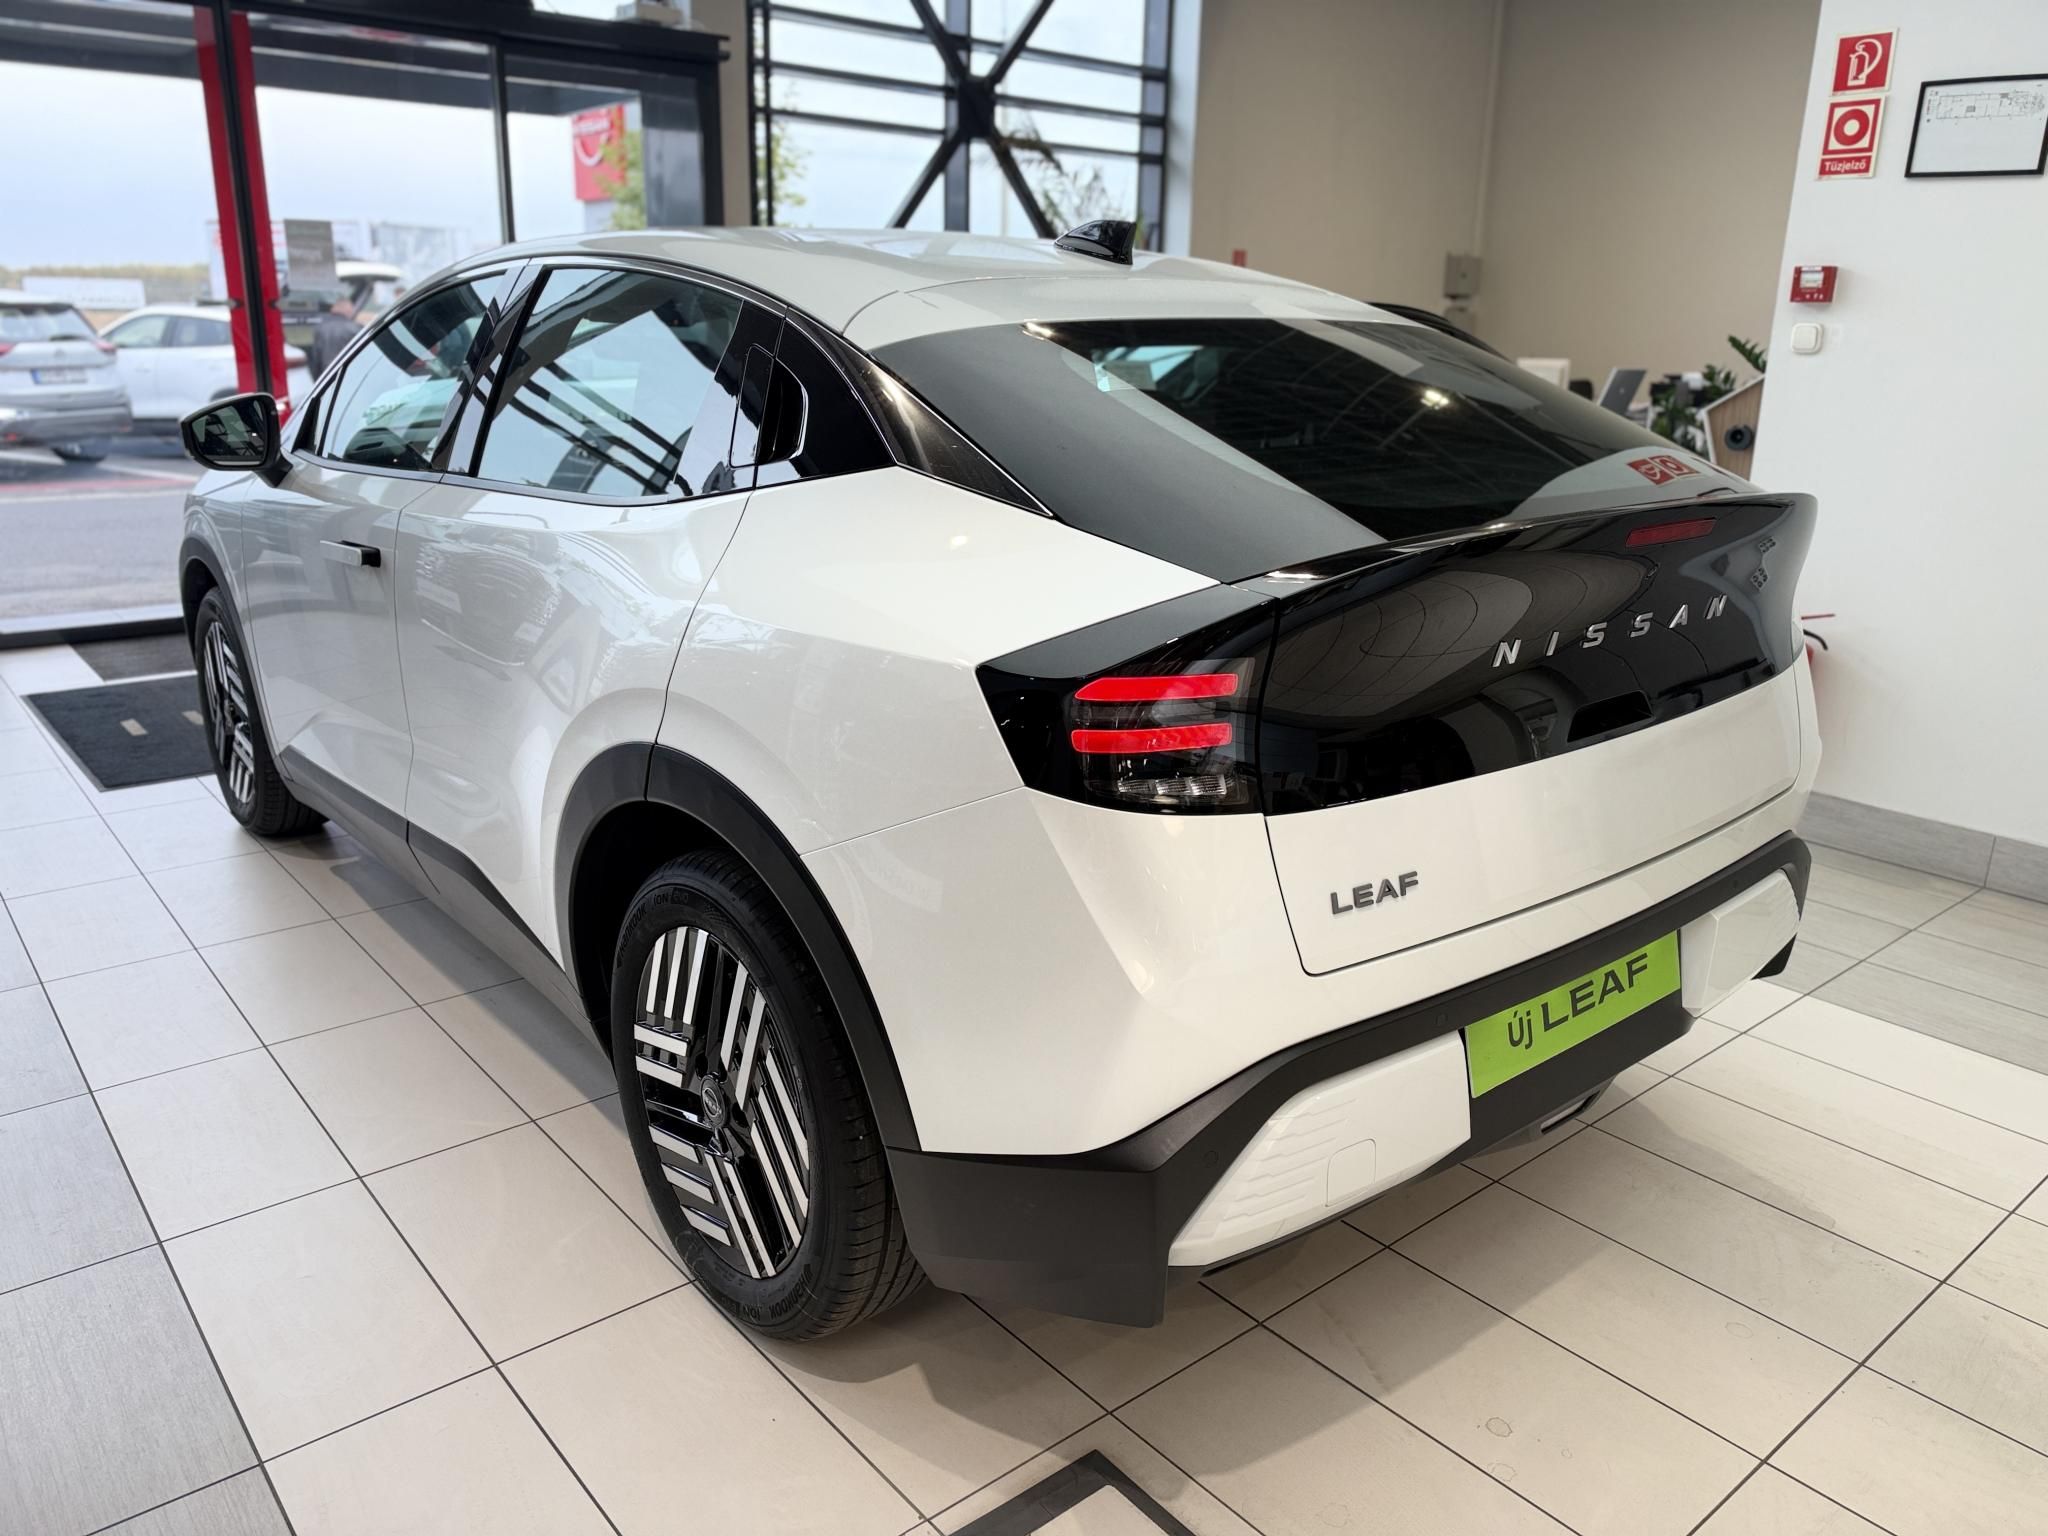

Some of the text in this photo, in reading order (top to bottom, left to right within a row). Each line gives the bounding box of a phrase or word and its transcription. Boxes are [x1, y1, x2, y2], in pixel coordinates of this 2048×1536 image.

[1491, 594, 1728, 668] NISSAN
[1330, 870, 1419, 915] LEAF
[1507, 952, 1648, 1050] Új LEAF
